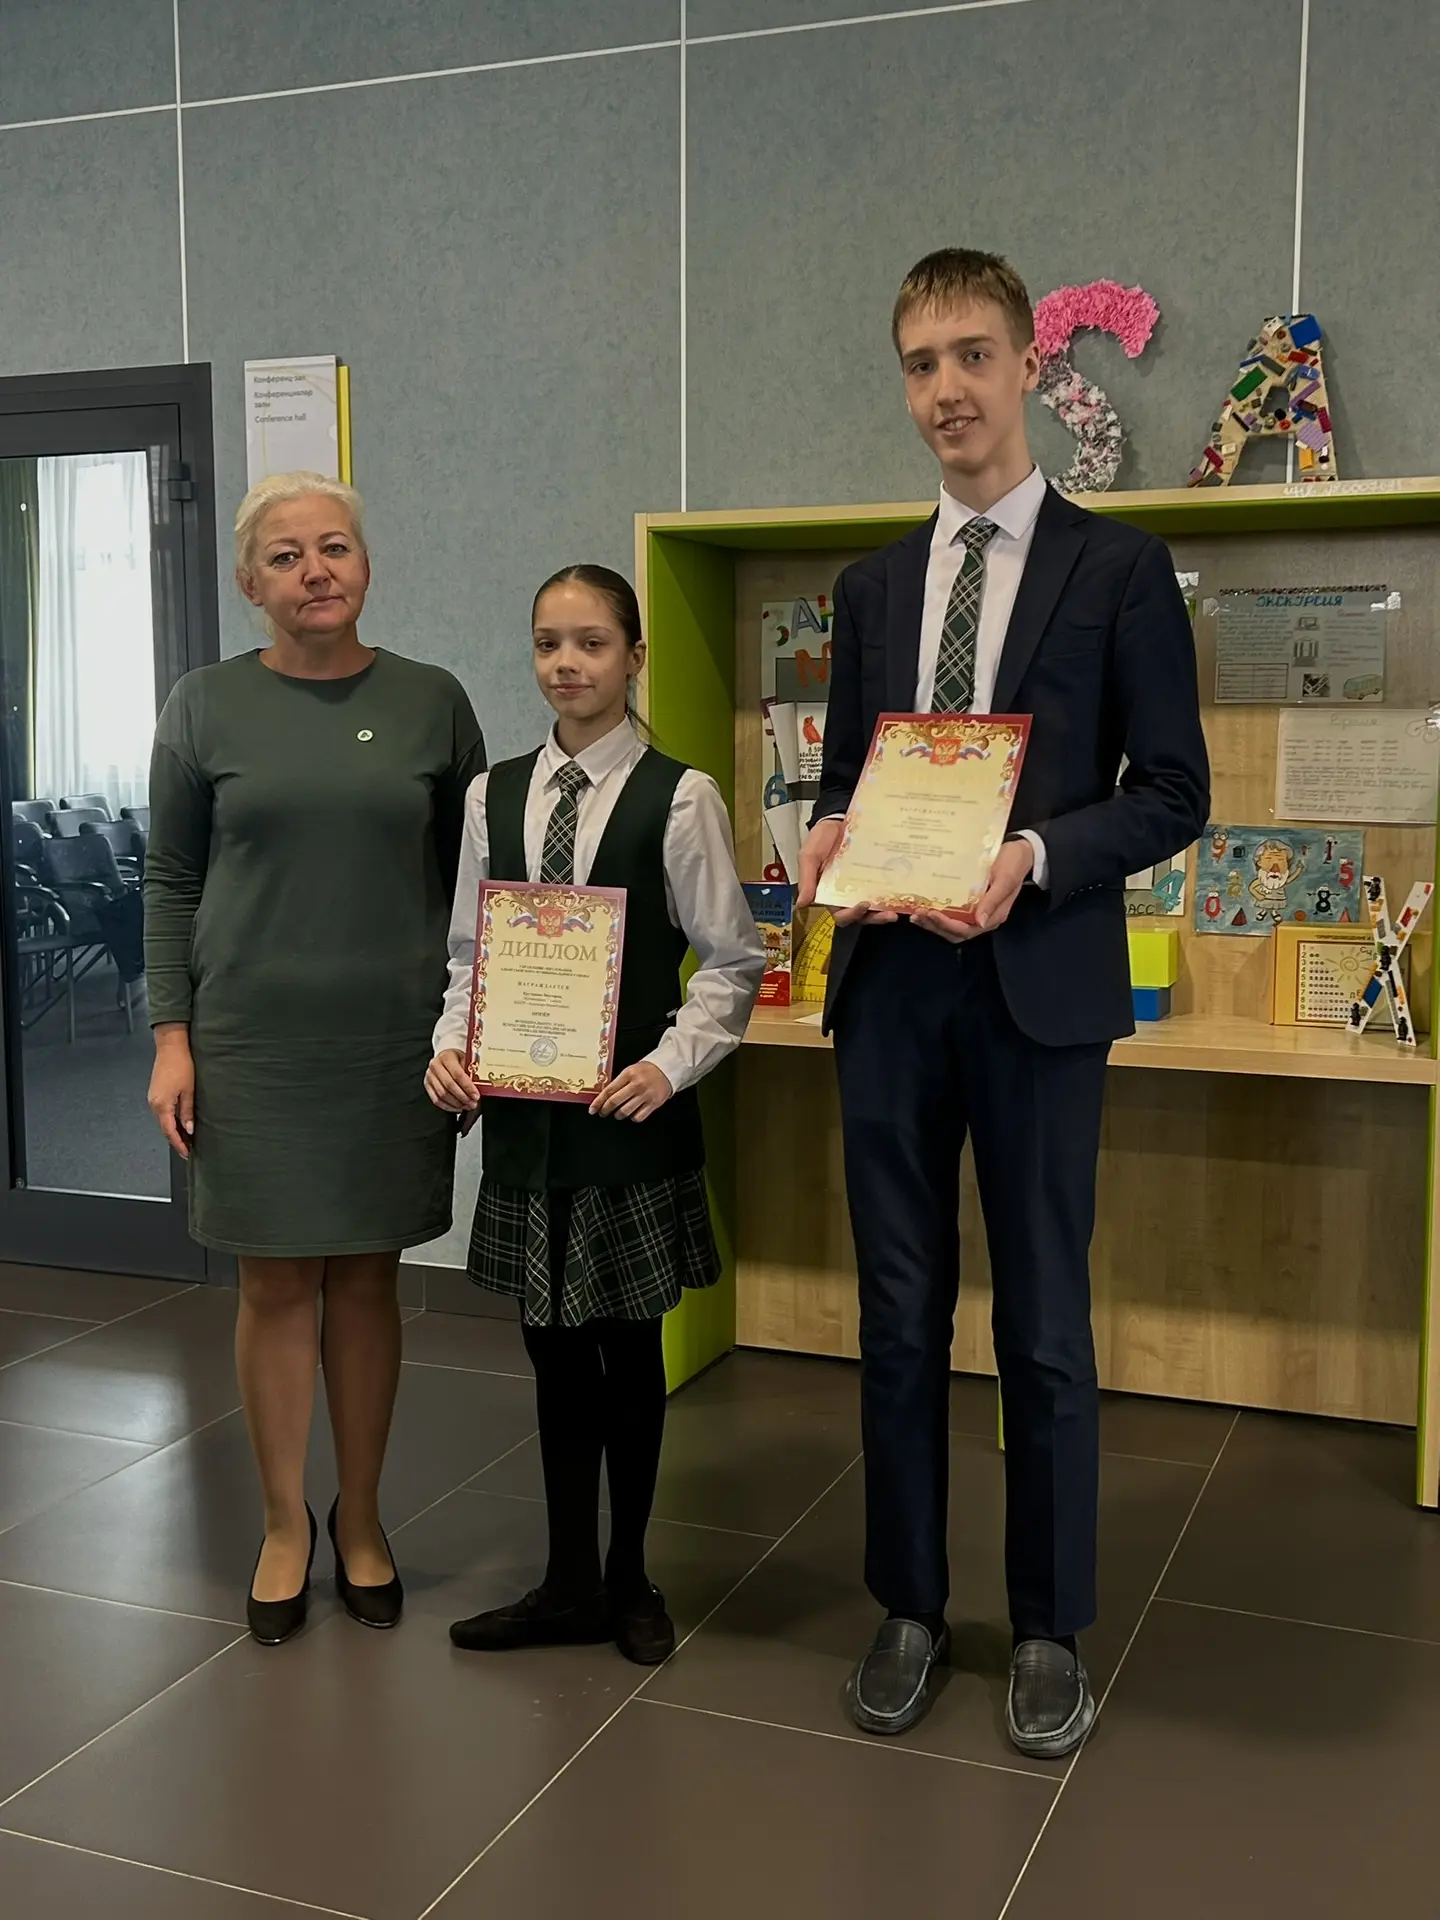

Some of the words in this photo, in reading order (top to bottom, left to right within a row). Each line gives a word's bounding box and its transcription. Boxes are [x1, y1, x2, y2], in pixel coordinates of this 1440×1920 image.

[1187, 313, 1339, 488] A
[255, 415, 293, 423] Conference
[295, 413, 306, 421] hall
[498, 940, 597, 961] ДИПЛОМ
